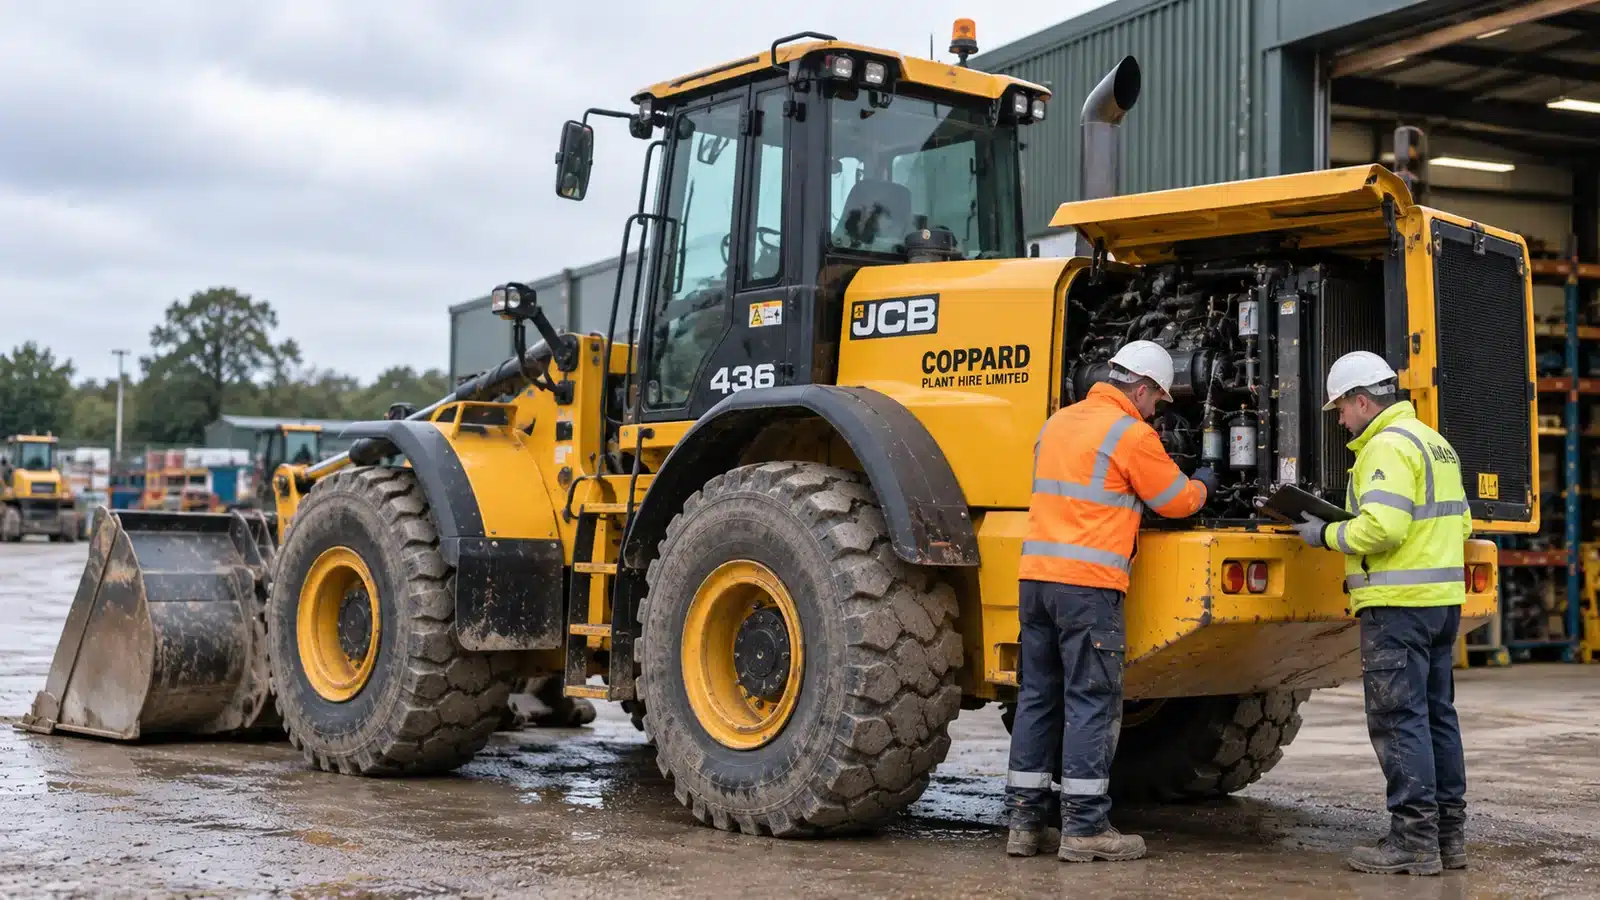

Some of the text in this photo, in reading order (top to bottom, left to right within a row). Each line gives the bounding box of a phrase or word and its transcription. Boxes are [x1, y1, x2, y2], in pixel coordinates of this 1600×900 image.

[852, 298, 936, 336] JCB
[922, 344, 1031, 375] COPPARD
[710, 363, 775, 394] 436
[922, 372, 1029, 389] PLANT HIRE LIMITED
